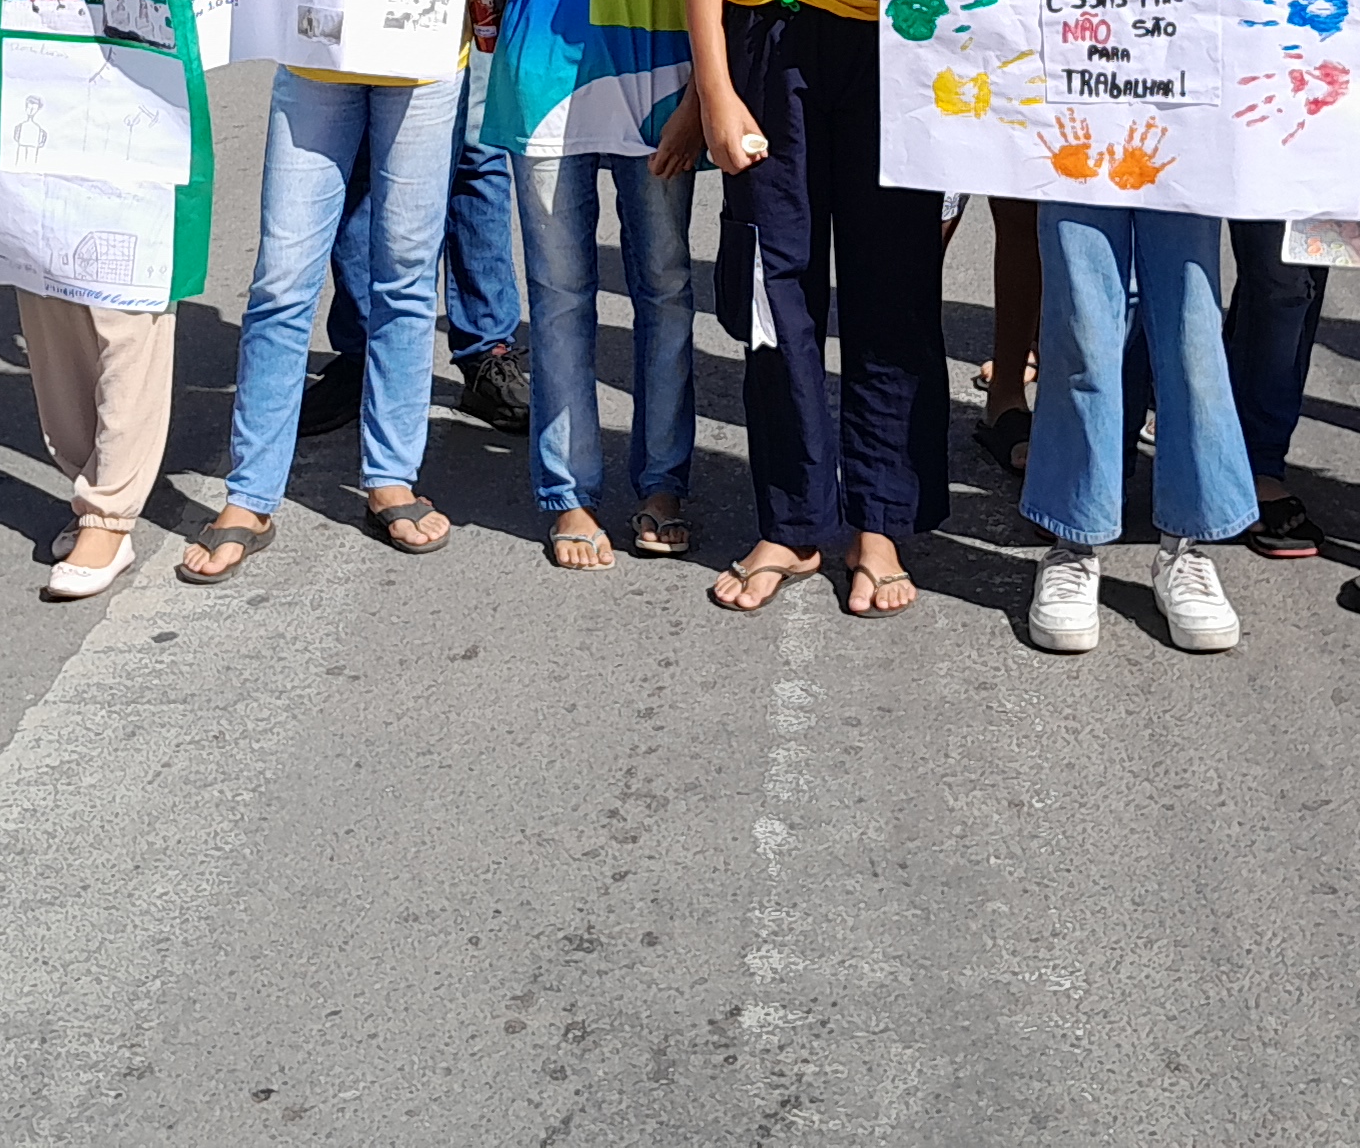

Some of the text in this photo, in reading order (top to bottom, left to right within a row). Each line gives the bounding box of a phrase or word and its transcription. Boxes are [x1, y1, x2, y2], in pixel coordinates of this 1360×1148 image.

[1061, 11, 1177, 45] NÃO SÃO
[1087, 44, 1131, 63] PARA
